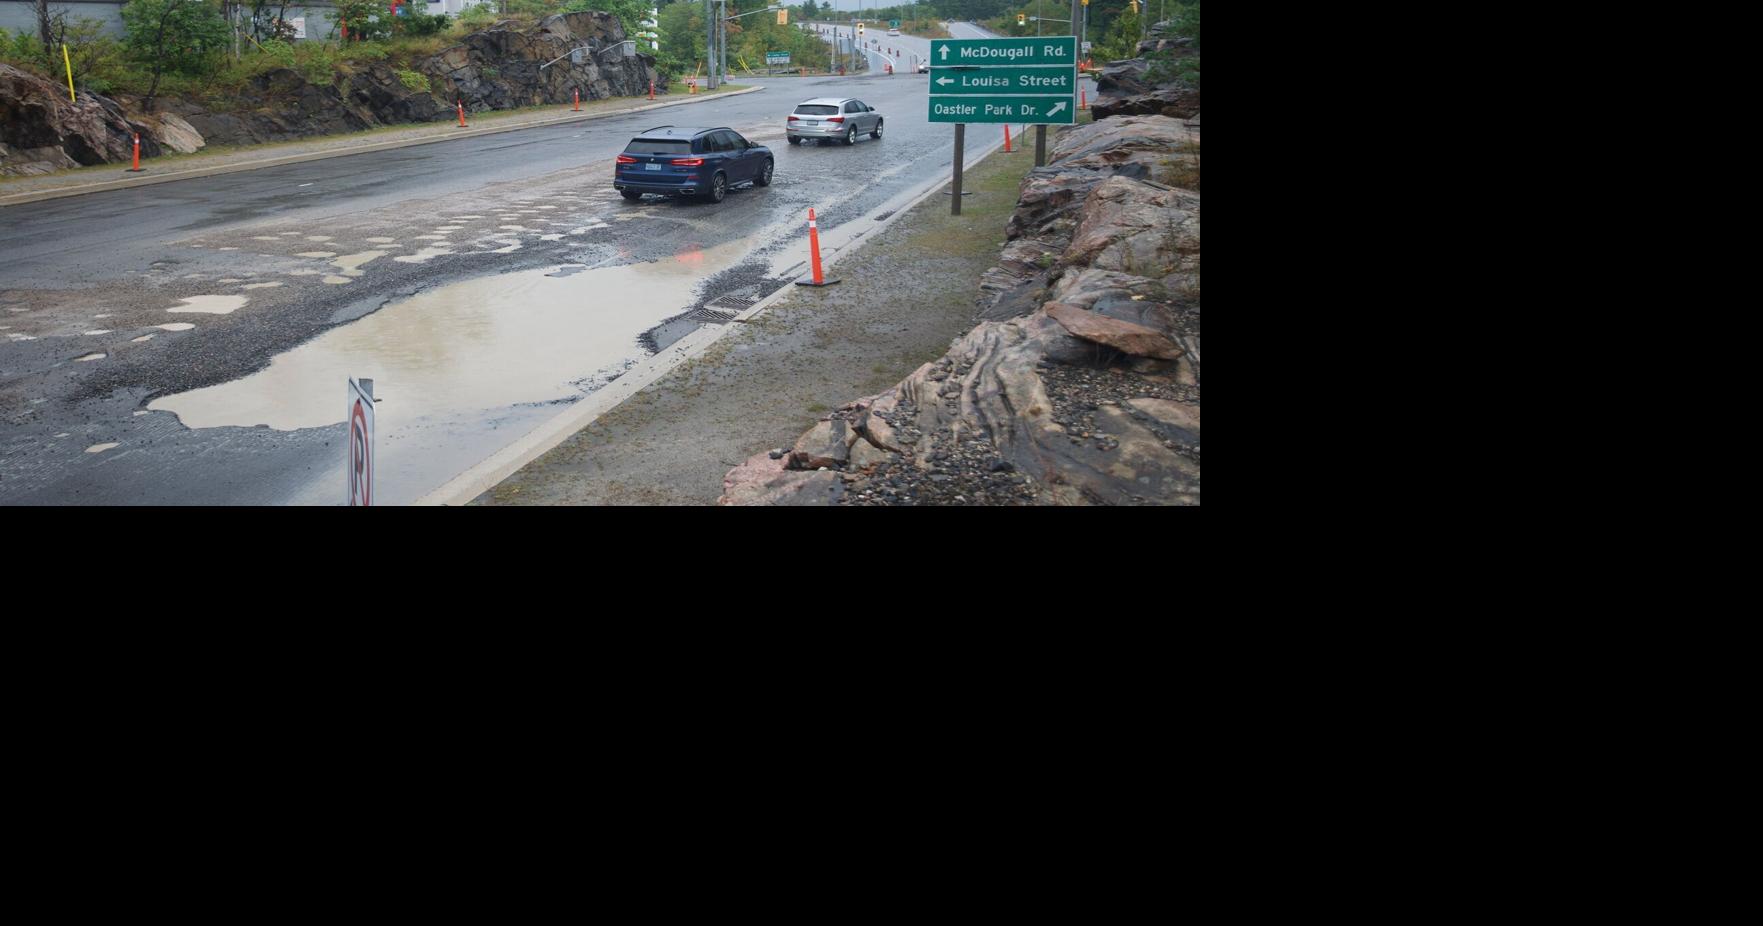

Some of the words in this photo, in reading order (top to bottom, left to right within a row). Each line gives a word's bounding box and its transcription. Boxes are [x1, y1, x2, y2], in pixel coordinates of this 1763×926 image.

[960, 46, 1034, 60] McDougall
[1043, 45, 1067, 57] Rd.
[962, 75, 1009, 87] Louisa
[1019, 74, 1067, 87] Street
[934, 103, 977, 115] Oastler
[984, 104, 1013, 116] Park
[1021, 105, 1039, 116] Dr.
